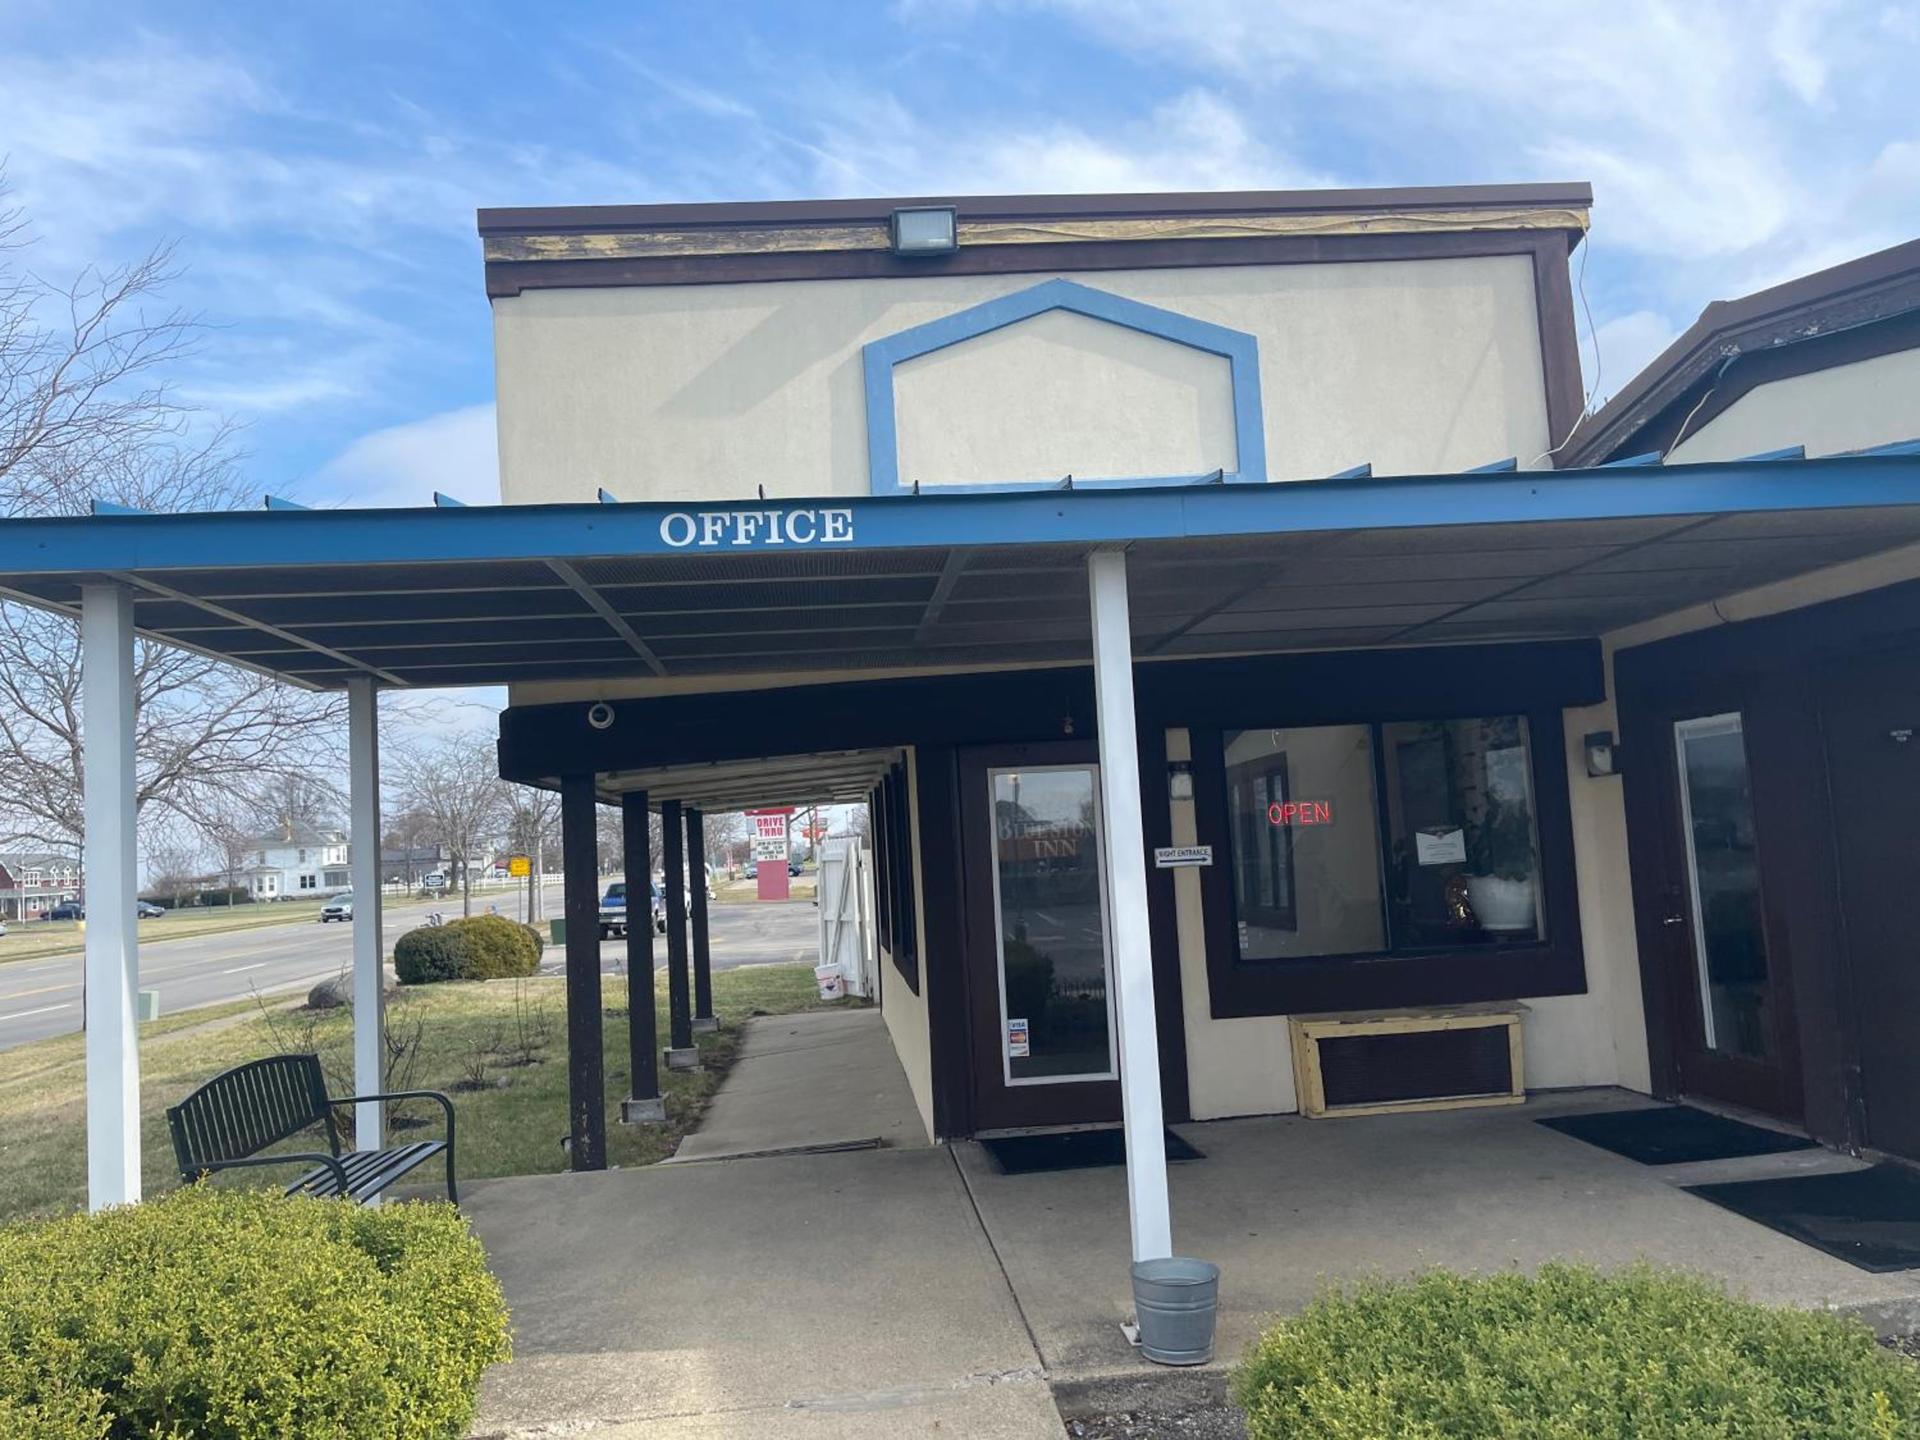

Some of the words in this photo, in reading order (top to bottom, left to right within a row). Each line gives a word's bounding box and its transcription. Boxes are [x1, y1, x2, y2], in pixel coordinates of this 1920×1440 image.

[660, 509, 854, 547] OFFICE
[1268, 800, 1330, 824] OPEN
[757, 817, 784, 828] DRIVE
[759, 828, 783, 837] THRU
[1032, 839, 1078, 858] INN
[1177, 847, 1209, 857] ENTRANCE
